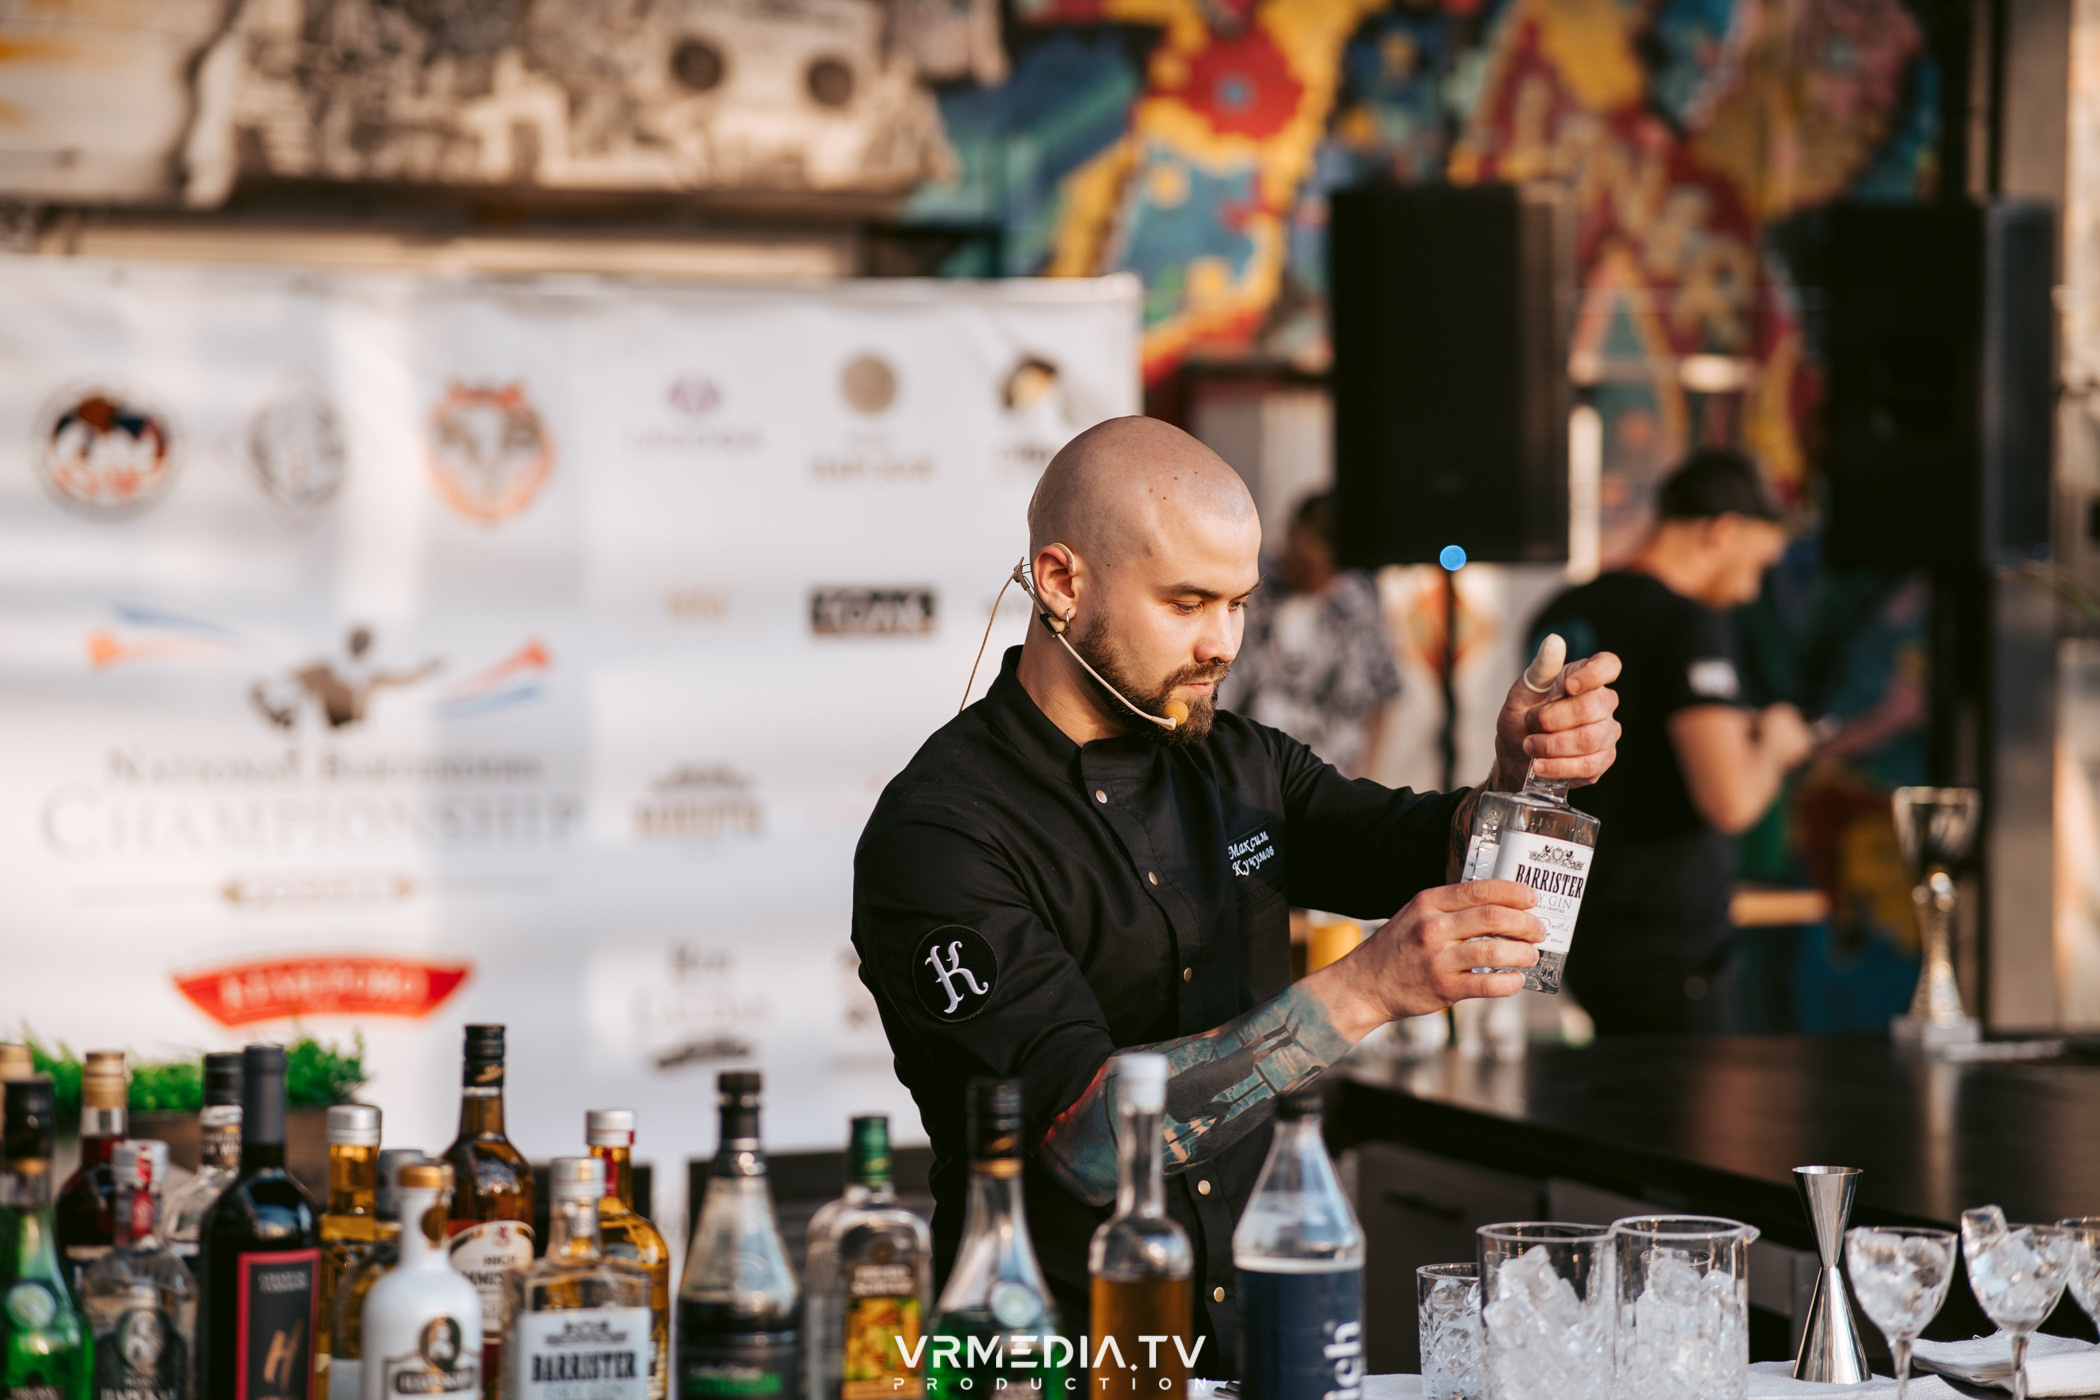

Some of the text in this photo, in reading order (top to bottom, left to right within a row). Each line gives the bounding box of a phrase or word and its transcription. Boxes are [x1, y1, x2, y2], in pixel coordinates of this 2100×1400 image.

[1228, 831, 1269, 860] Максим
[1515, 863, 1584, 899] BARRISTER
[1548, 895, 1572, 909] GIN
[531, 1350, 637, 1383] BARRISTER
